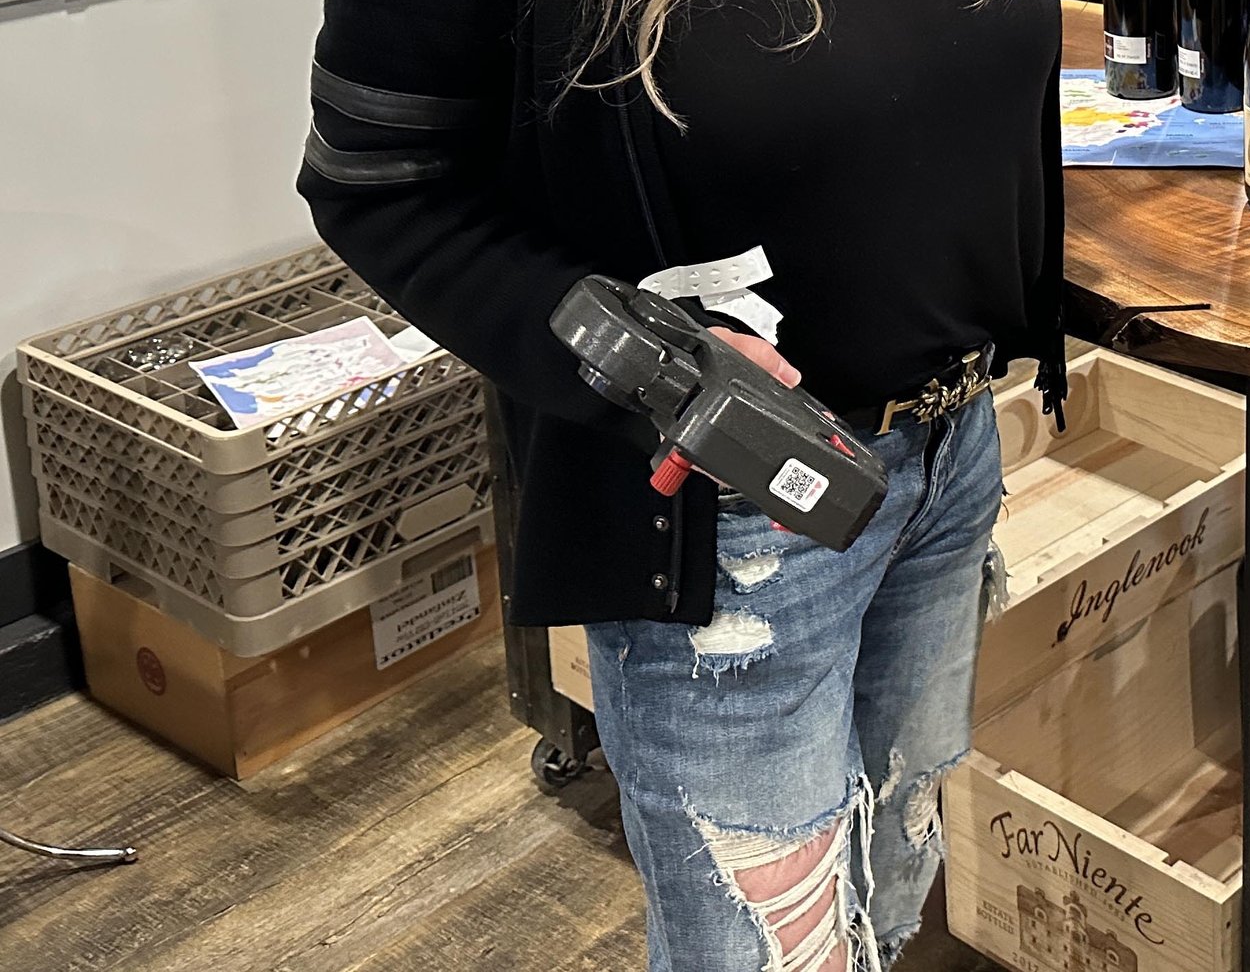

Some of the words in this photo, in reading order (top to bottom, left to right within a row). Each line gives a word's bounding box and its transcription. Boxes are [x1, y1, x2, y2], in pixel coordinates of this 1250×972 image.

[1052, 507, 1209, 647] Inglenook
[380, 607, 479, 665] Predator
[397, 590, 466, 632] Zinfandel
[990, 811, 1044, 859] Far
[1043, 821, 1165, 945] Niente
[976, 905, 1015, 935] BOTTLED
[982, 899, 1015, 924] ESTATE
